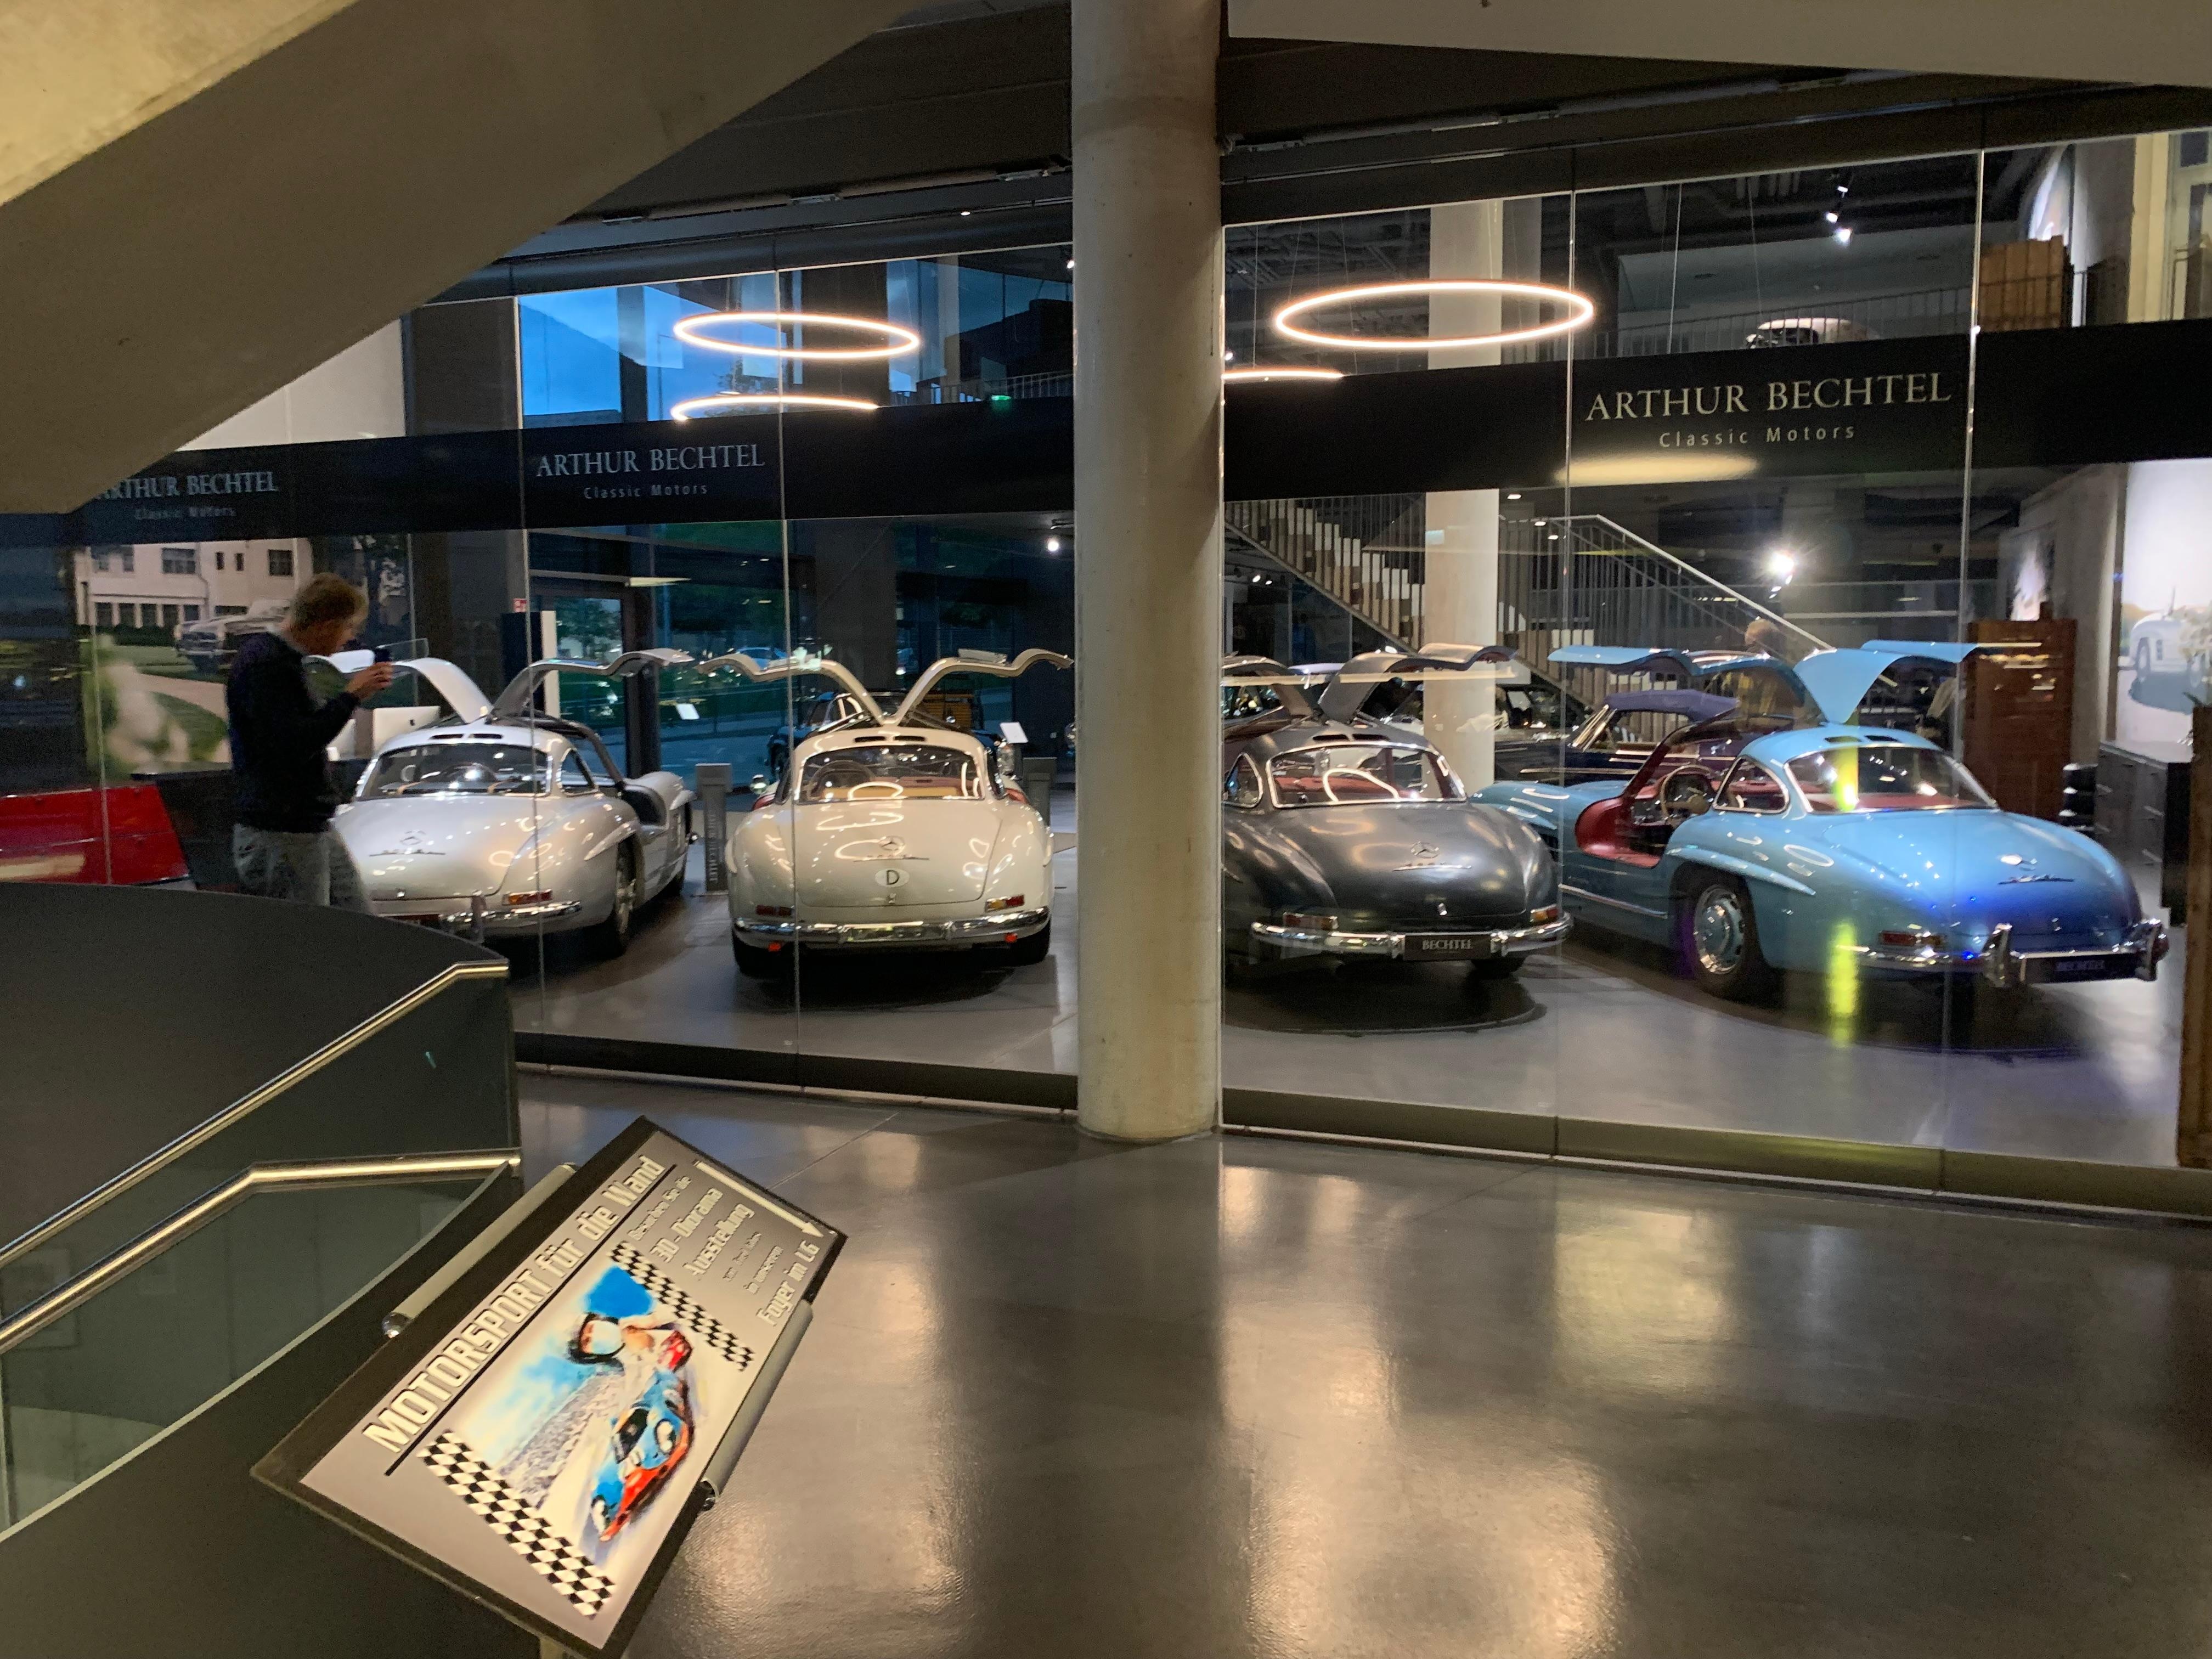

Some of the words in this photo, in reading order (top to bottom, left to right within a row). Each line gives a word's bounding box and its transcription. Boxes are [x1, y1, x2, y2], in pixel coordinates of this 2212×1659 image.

[1584, 385, 1750, 421] ARTHUR
[1767, 372, 1952, 411] BECHTEL
[1659, 429, 1748, 448] Classic
[1765, 426, 1855, 442] Motors
[535, 450, 641, 477] ARTHUR
[650, 444, 766, 471] BECHTEL
[187, 471, 279, 495] BECHTEL
[583, 485, 641, 499] Classic
[651, 484, 708, 496] Motors
[886, 870, 900, 885] D
[1422, 939, 1474, 951] BECHTEL
[682, 1203, 755, 1280] Ausstellung
[794, 1240, 821, 1262] UG
[782, 1262, 809, 1282] im
[362, 1268, 553, 1453] MOTORSPORT
[534, 1237, 585, 1278] für
[575, 1205, 620, 1241] die
[601, 1154, 666, 1207] Wand
[756, 1280, 795, 1327] Foyer
